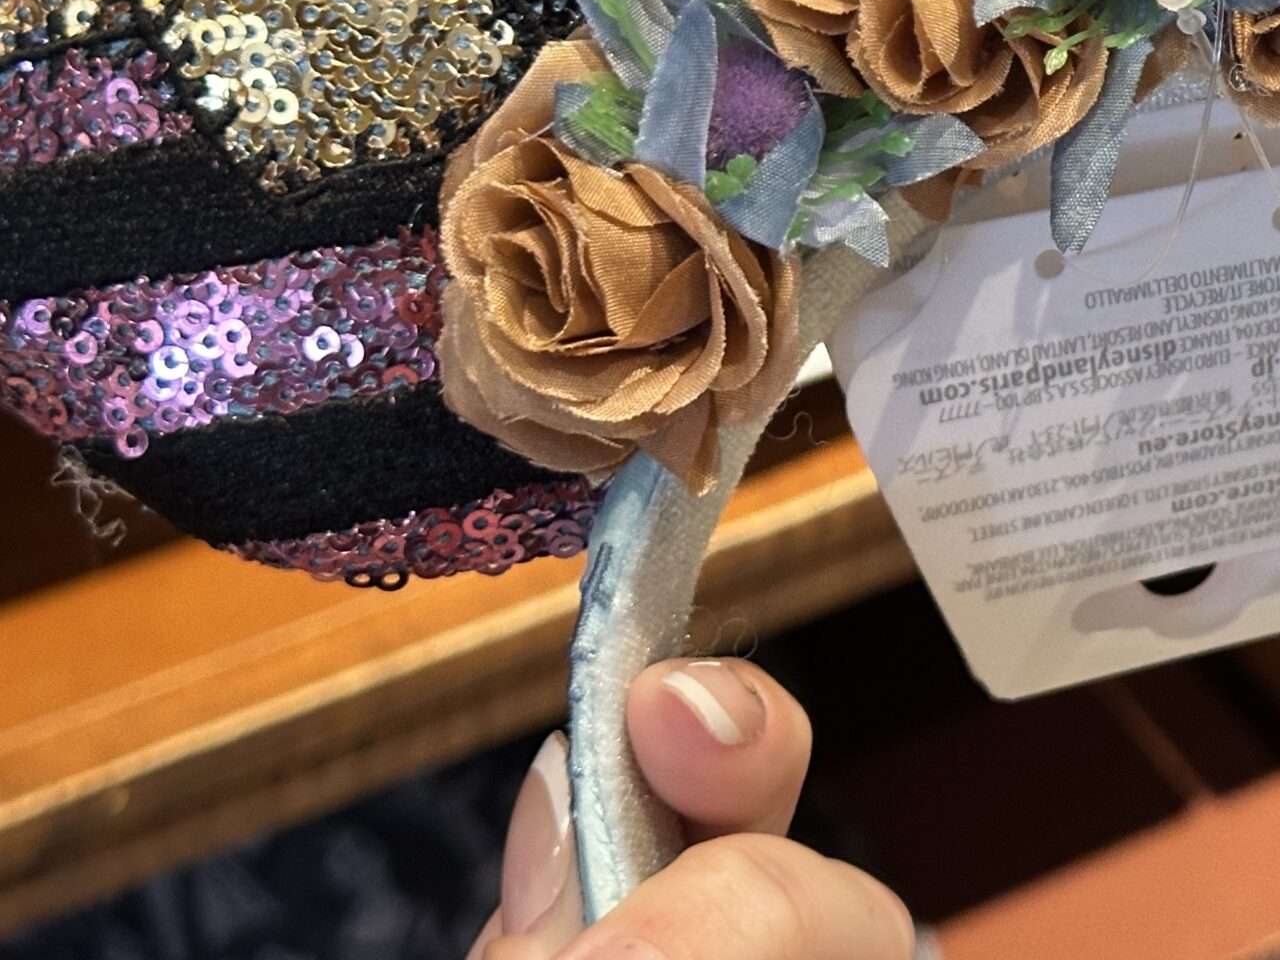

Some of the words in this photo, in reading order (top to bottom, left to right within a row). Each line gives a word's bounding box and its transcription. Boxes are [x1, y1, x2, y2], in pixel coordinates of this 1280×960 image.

[1229, 298, 1269, 321] KONG
[1142, 306, 1229, 339] DISNEYLAND
[1178, 327, 1231, 353] FRANCE
[931, 358, 976, 382] HONG
[1143, 356, 1193, 380] DISNEY
[1193, 348, 1231, 370] EURO
[890, 367, 933, 390] KONG
[917, 338, 1177, 407] disneylandparis.com
